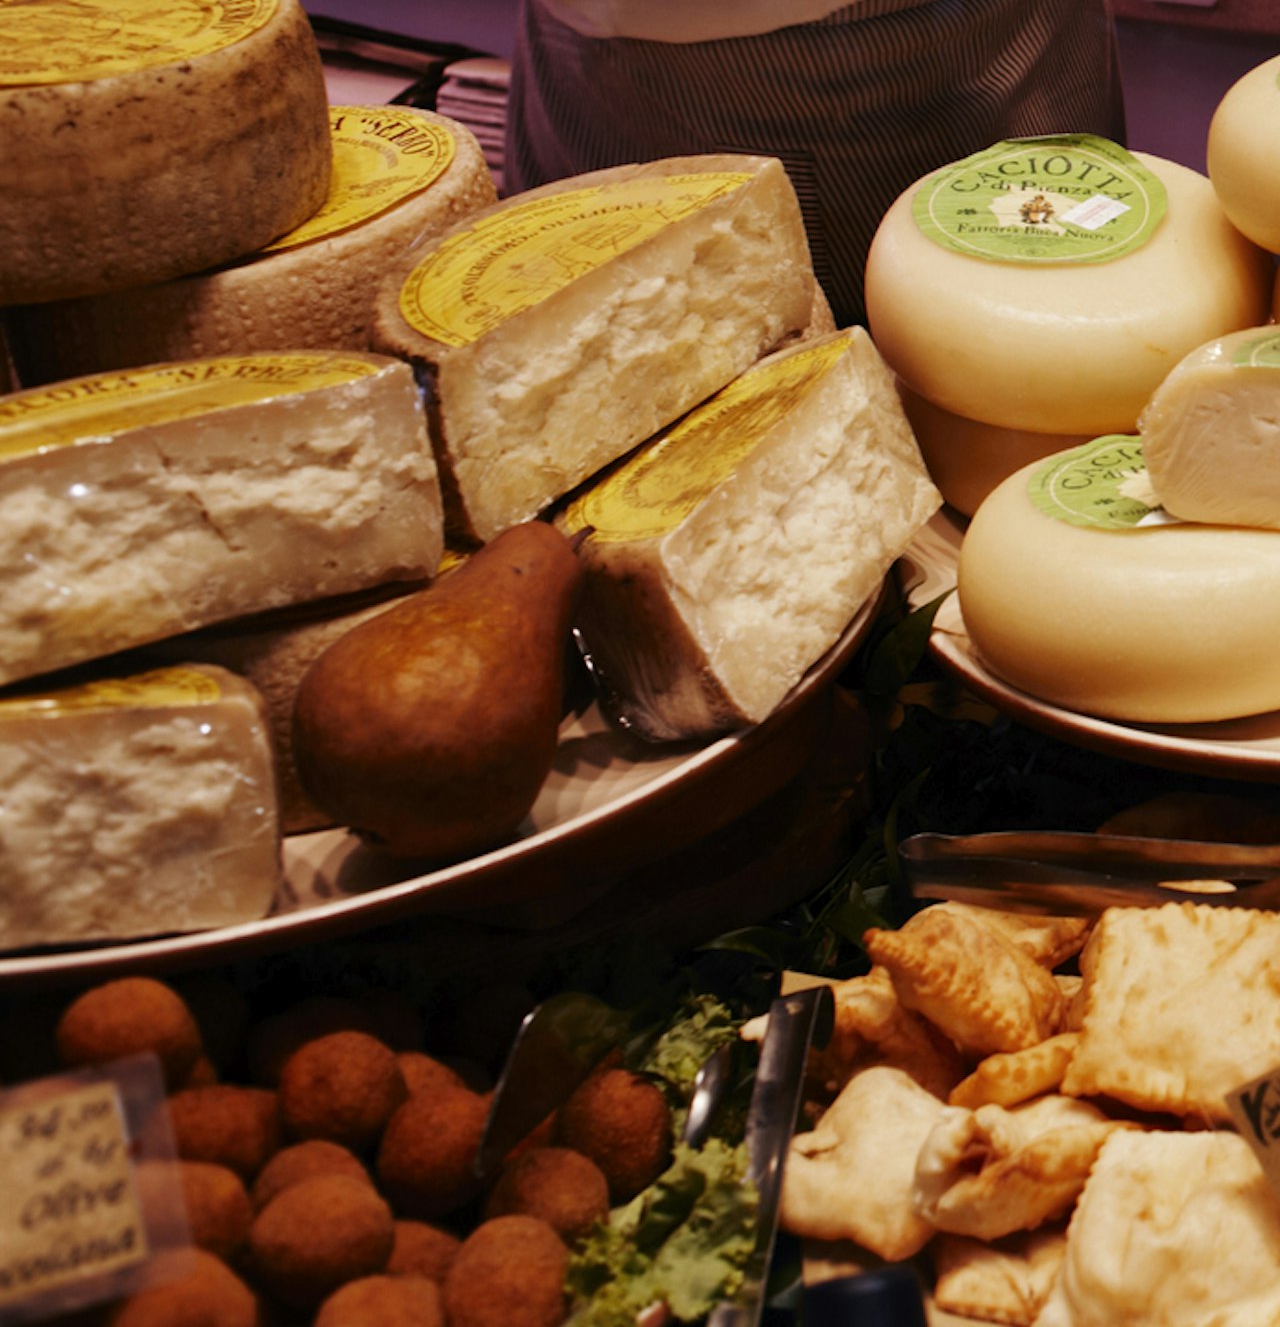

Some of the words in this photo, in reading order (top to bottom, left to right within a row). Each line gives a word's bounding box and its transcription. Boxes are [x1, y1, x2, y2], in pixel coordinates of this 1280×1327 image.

[950, 154, 1134, 203] CACIOTTA
[990, 179, 1012, 192] di
[1020, 180, 1092, 196] Pienza
[956, 222, 1019, 235] Fattoria
[1064, 228, 1115, 243] Nuova
